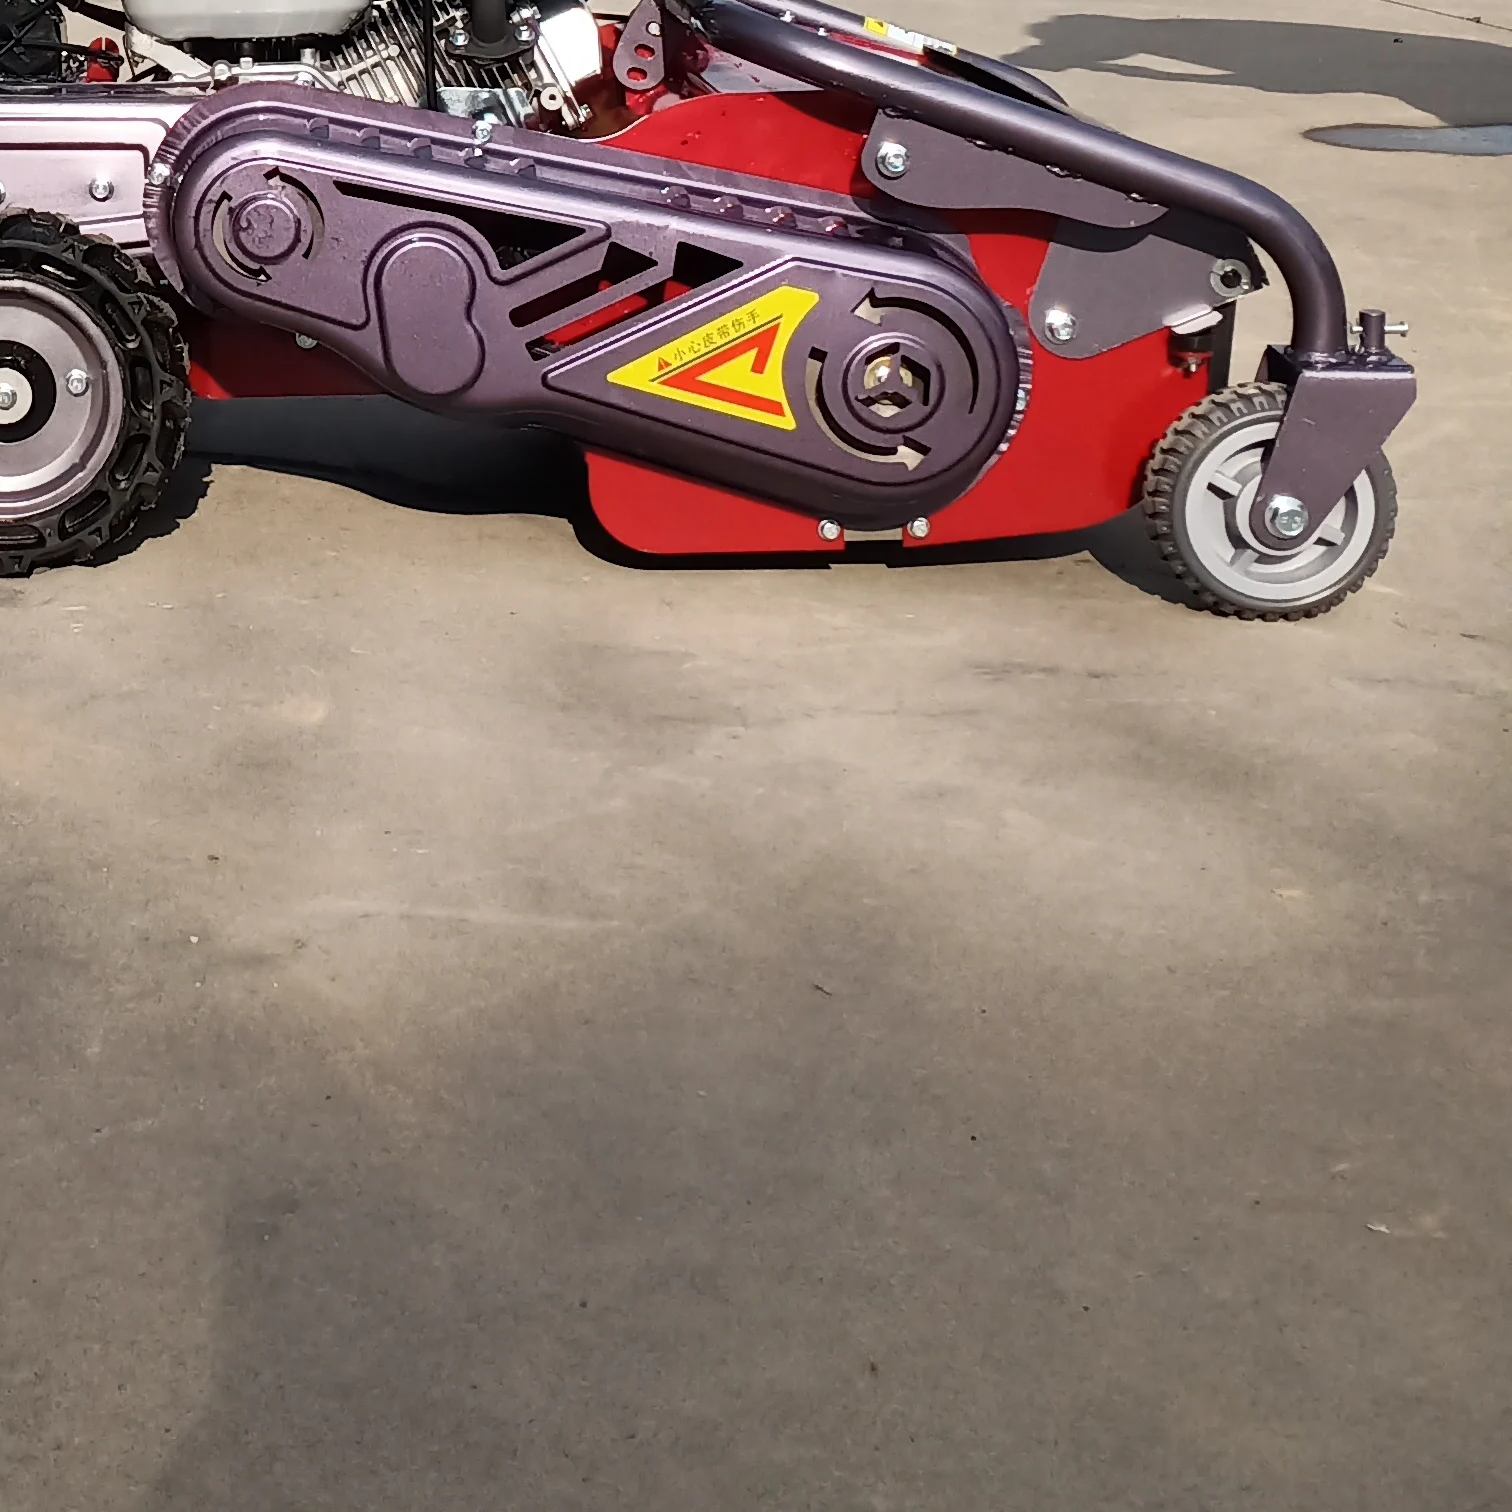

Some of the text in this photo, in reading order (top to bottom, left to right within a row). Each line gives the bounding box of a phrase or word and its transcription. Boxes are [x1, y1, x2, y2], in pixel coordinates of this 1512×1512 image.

[673, 308, 760, 361] 小心皮带伤手
